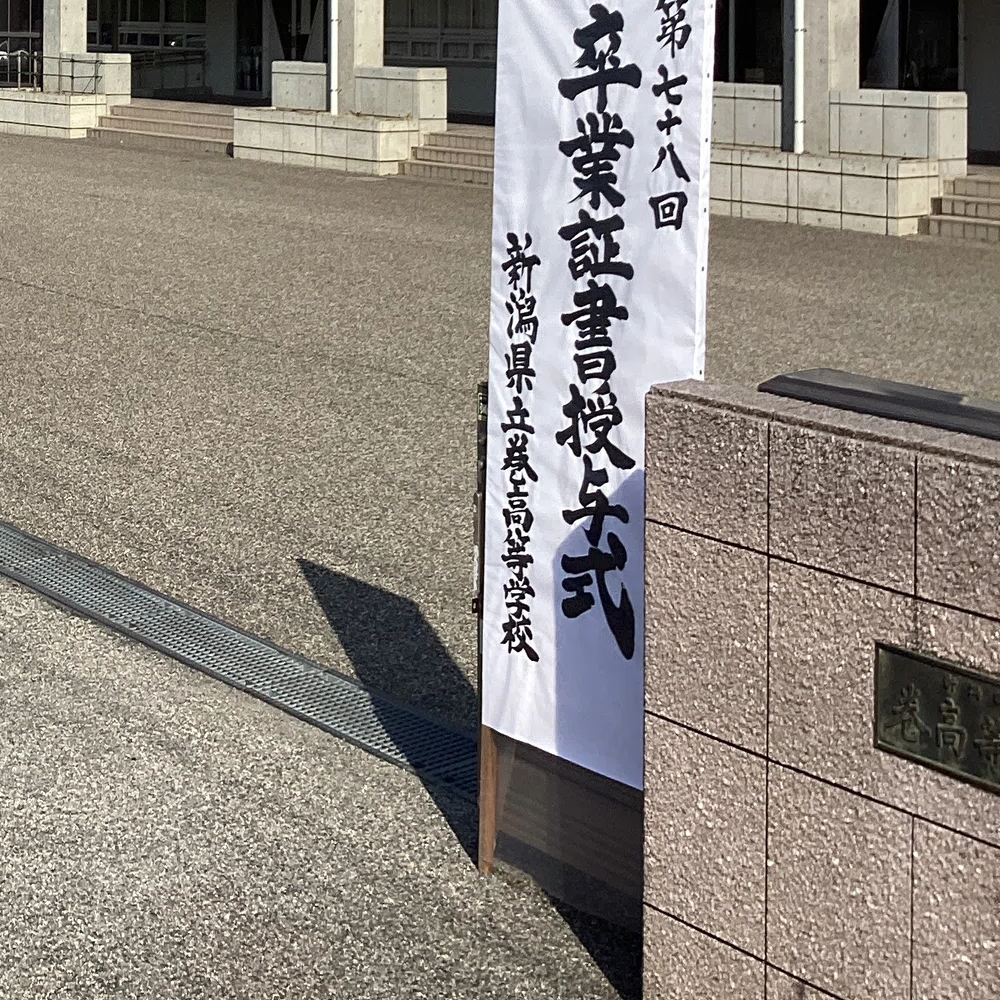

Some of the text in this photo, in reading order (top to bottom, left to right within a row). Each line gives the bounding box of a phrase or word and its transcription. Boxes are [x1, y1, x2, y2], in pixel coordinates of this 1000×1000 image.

[500, 232, 541, 662] 新潟県立巻高等学校
[556, 3, 642, 660] 卒業証書授与式
